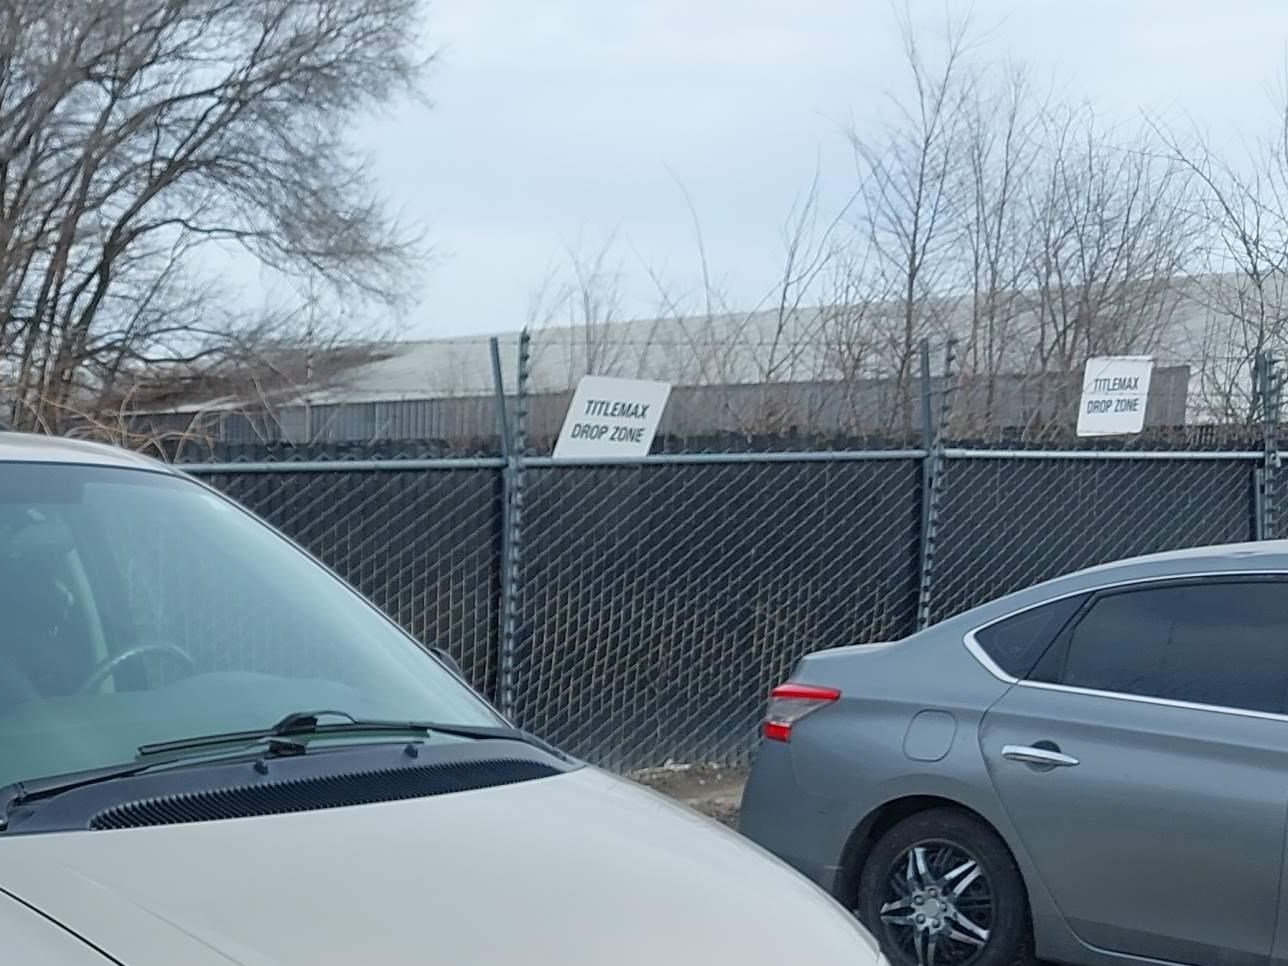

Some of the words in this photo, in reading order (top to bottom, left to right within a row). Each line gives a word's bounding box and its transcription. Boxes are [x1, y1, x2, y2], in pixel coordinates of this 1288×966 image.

[1094, 377, 1139, 391] TITLEMAX
[584, 399, 650, 418] TITLEMAX
[1087, 400, 1112, 414] DROP
[1114, 398, 1139, 412] ZONE
[571, 423, 608, 441] DROP
[609, 425, 644, 443] ZONE
